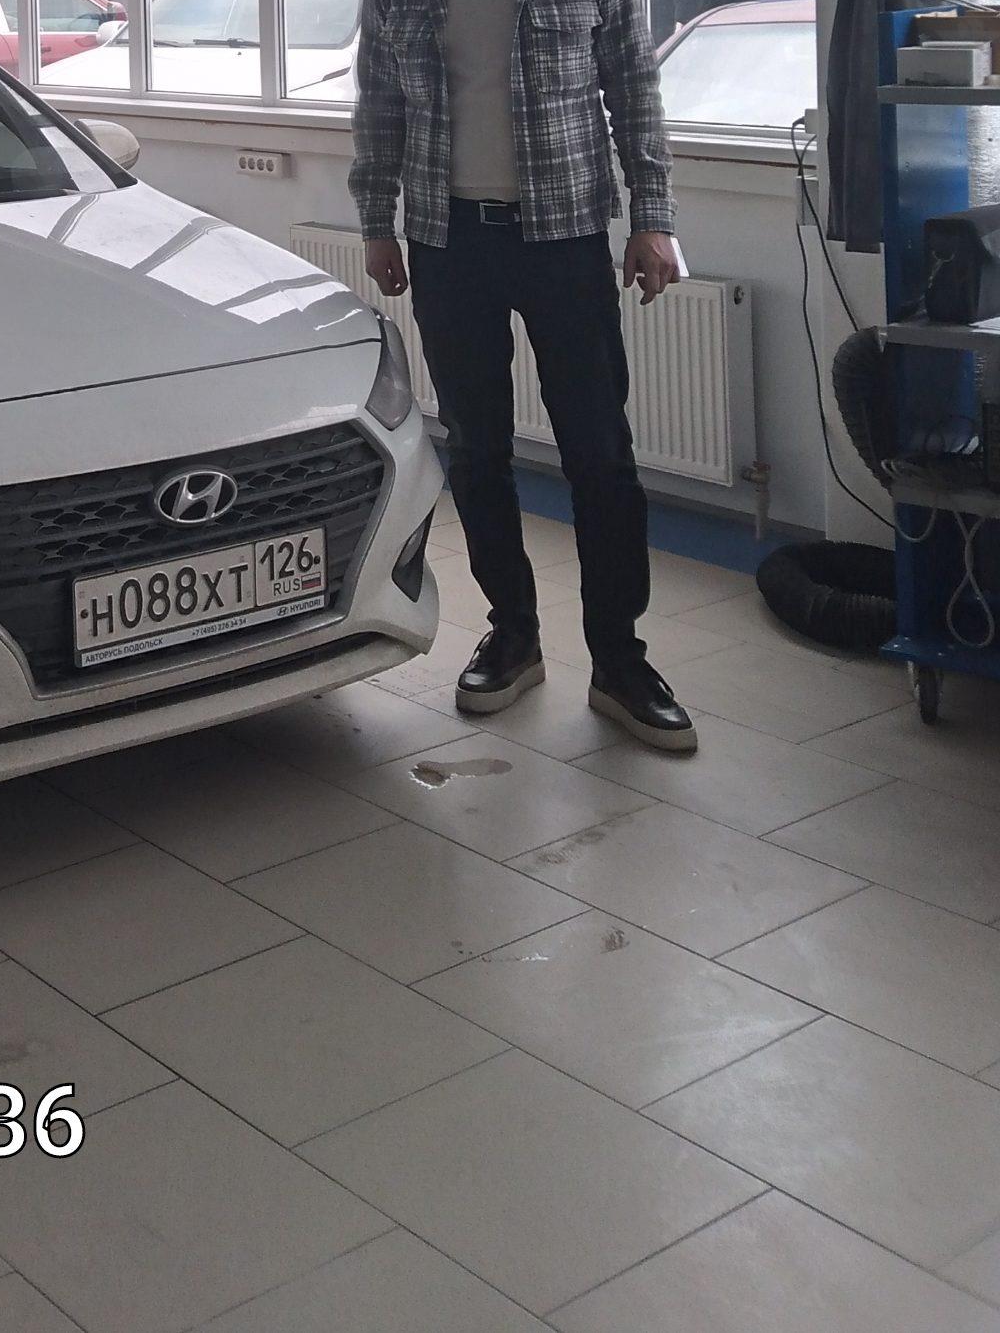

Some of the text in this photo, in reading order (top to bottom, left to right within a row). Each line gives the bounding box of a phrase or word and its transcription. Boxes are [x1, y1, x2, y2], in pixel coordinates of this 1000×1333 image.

[91, 537, 313, 637] Н088ХТ 126
[273, 576, 300, 597] RUS
[290, 598, 321, 613] HYUNDAI
[85, 638, 164, 663] АВТОРУСЬ ПОДОЛЬСК
